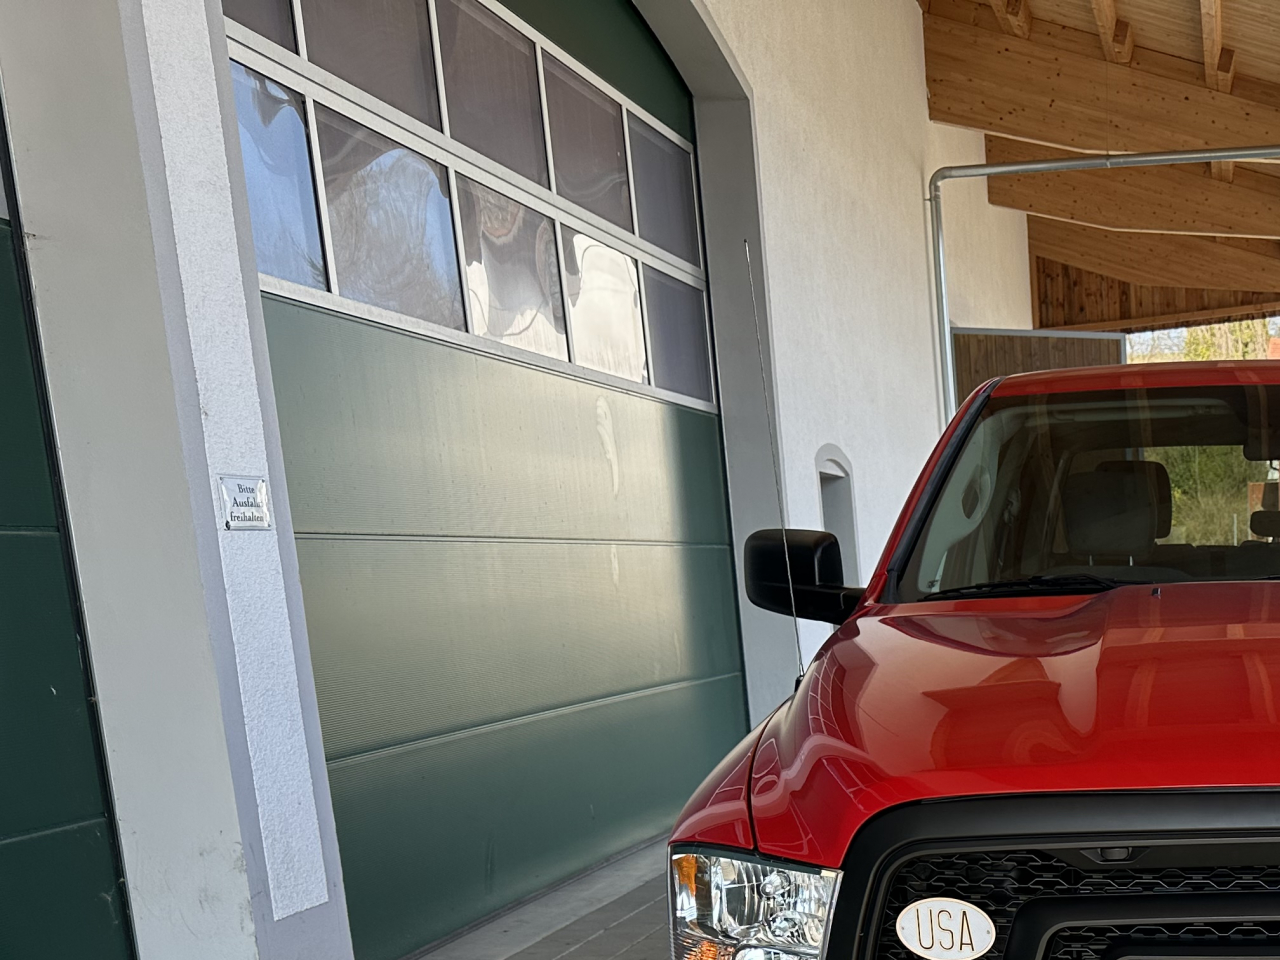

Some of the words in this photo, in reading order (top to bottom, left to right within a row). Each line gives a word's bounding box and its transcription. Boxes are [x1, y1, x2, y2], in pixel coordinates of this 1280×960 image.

[237, 483, 255, 494] Bitte
[230, 511, 264, 522] freihalten
[916, 908, 975, 952] USA
